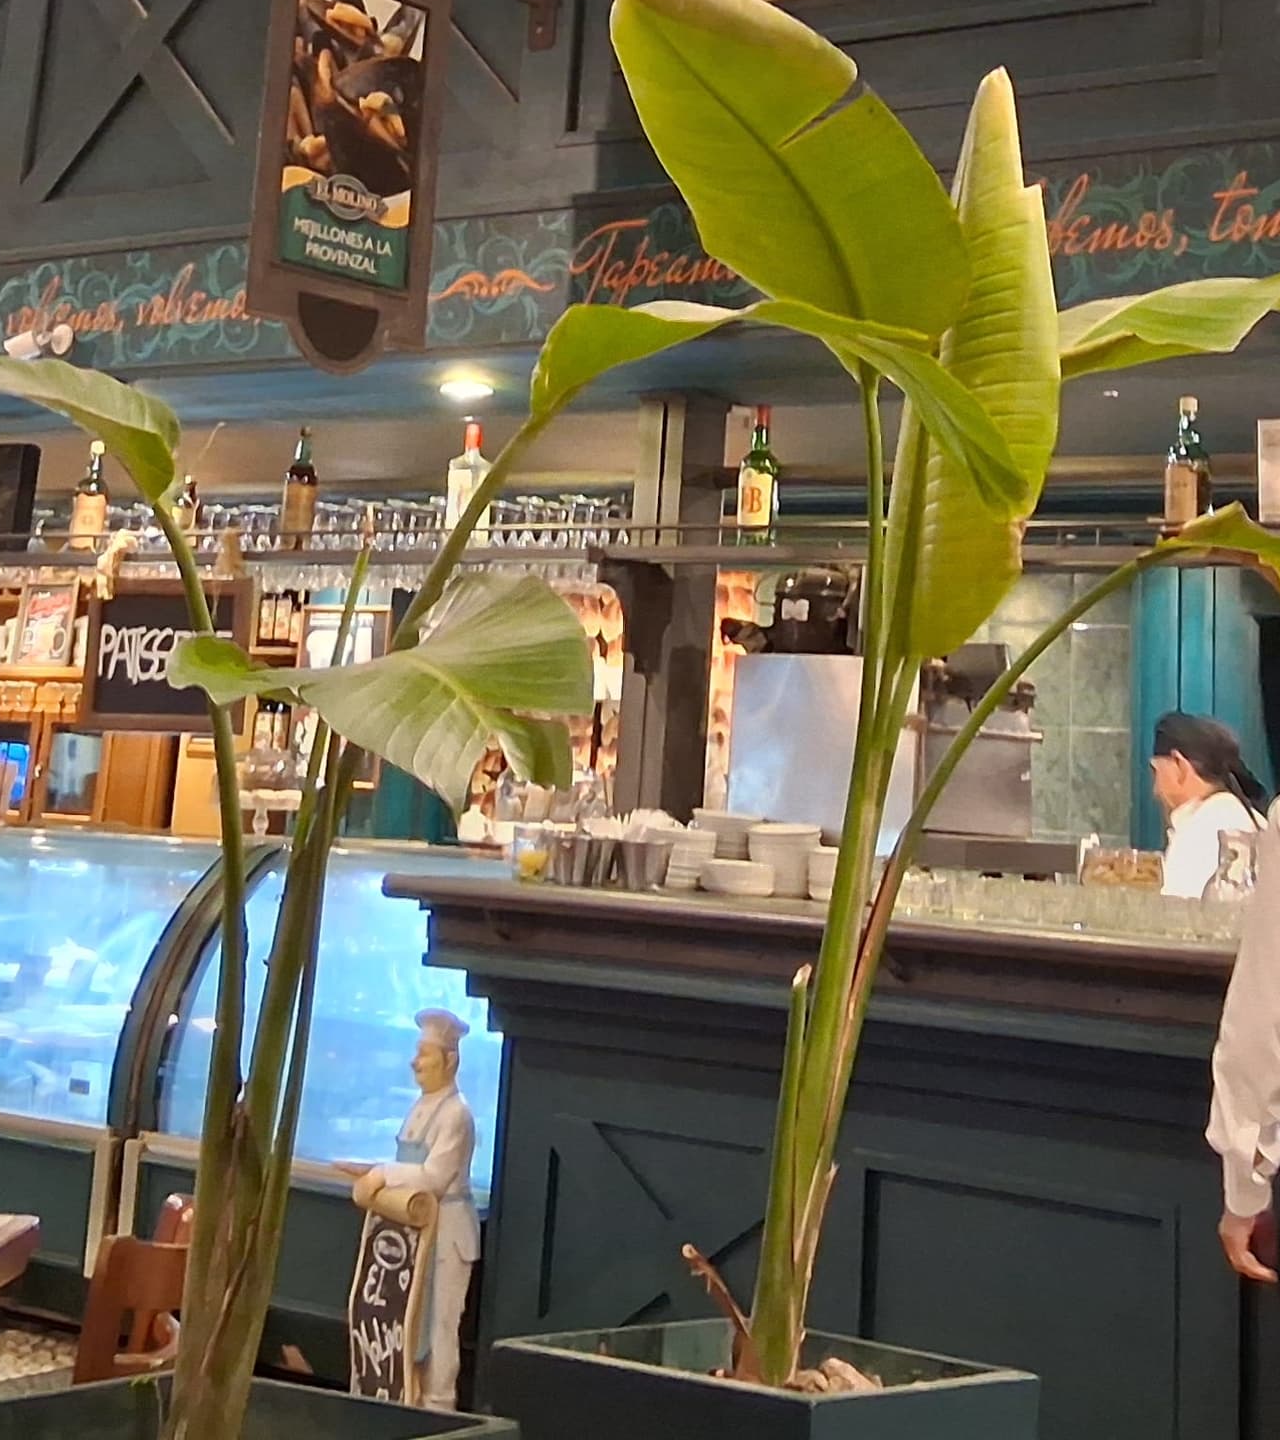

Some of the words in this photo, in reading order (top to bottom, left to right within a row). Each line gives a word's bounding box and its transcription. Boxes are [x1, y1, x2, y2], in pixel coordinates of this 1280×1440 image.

[293, 216, 364, 250] MEJILLONES
[364, 236, 374, 252] A
[376, 239, 393, 257] LA
[305, 240, 377, 275] PROVENZAL
